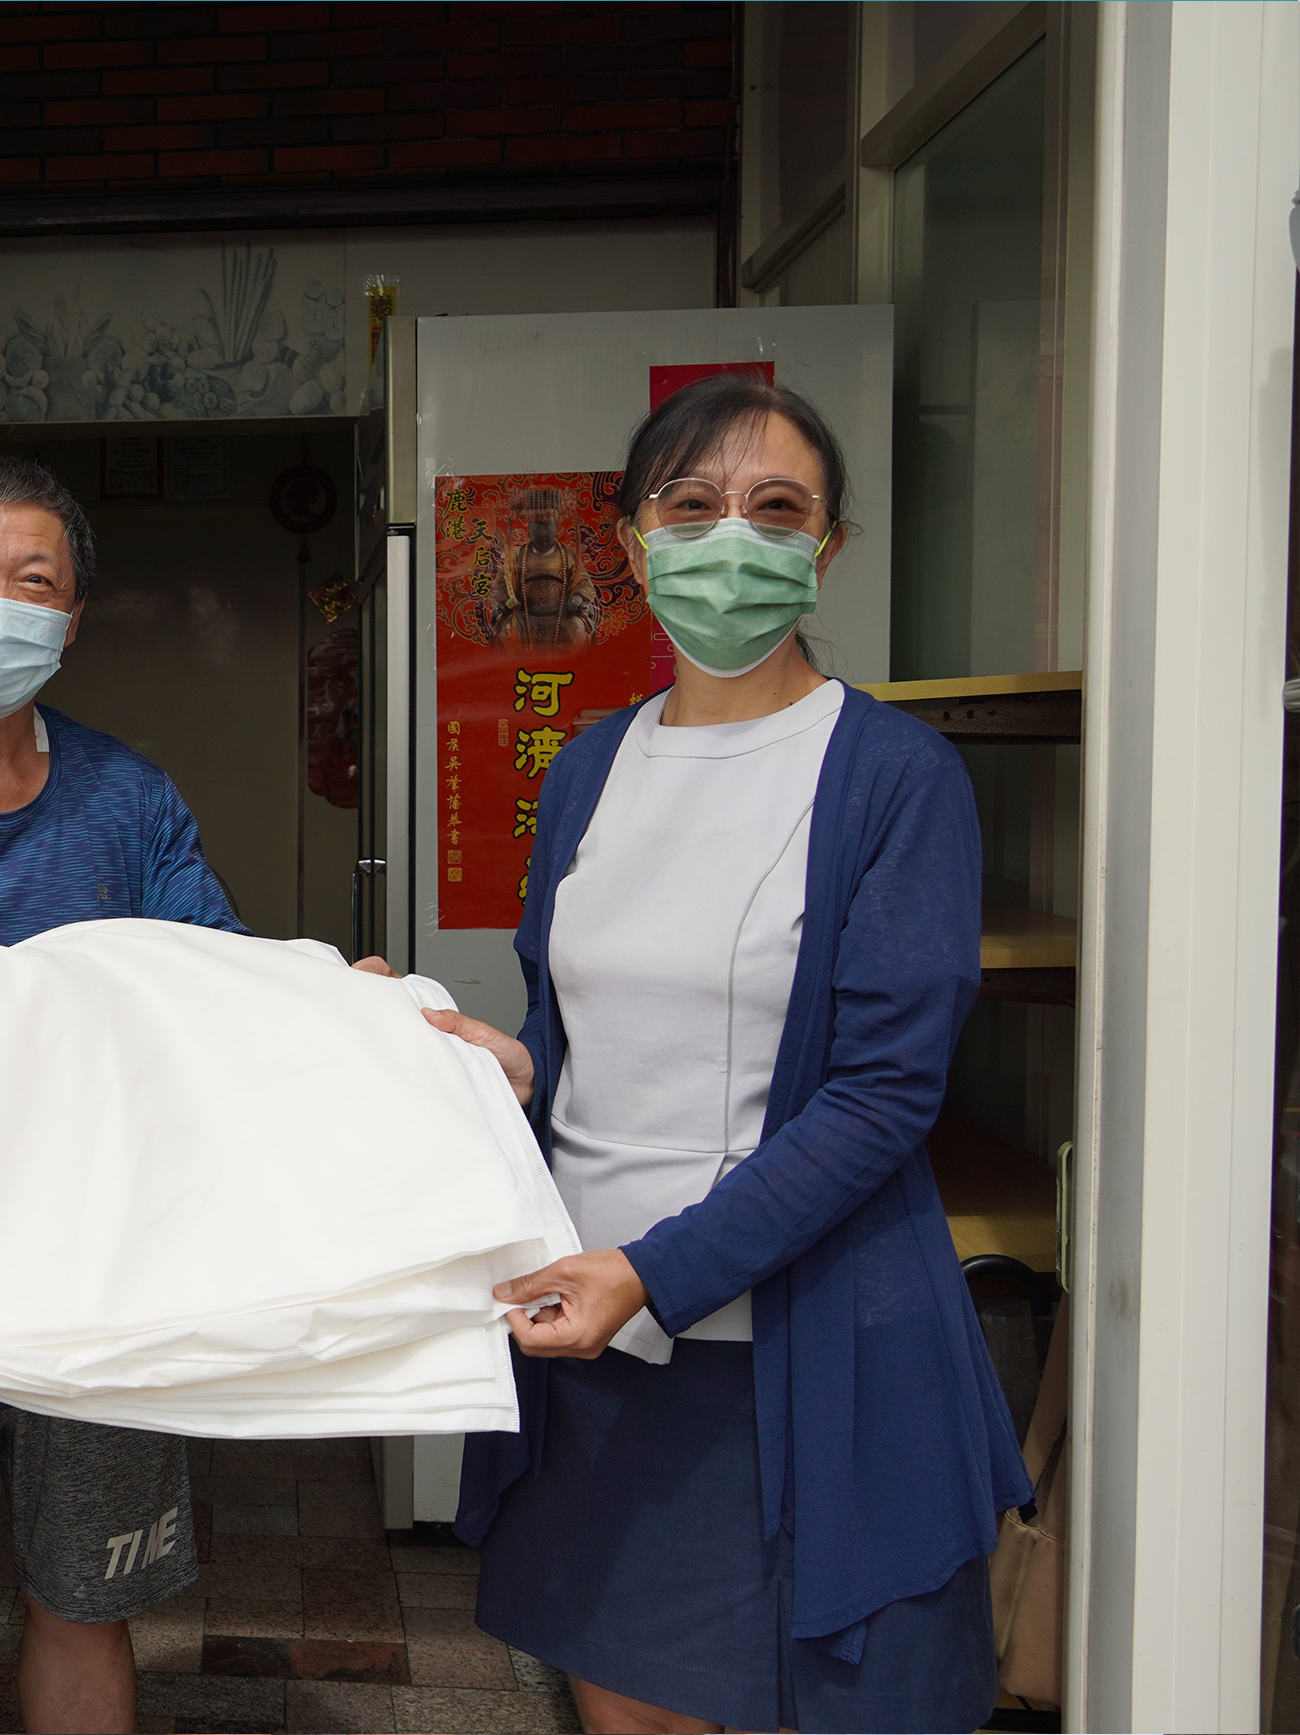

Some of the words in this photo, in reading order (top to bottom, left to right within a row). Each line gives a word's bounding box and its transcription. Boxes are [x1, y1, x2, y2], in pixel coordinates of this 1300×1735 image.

[442, 488, 468, 541] 鹿港
[468, 519, 494, 598] 天后宮
